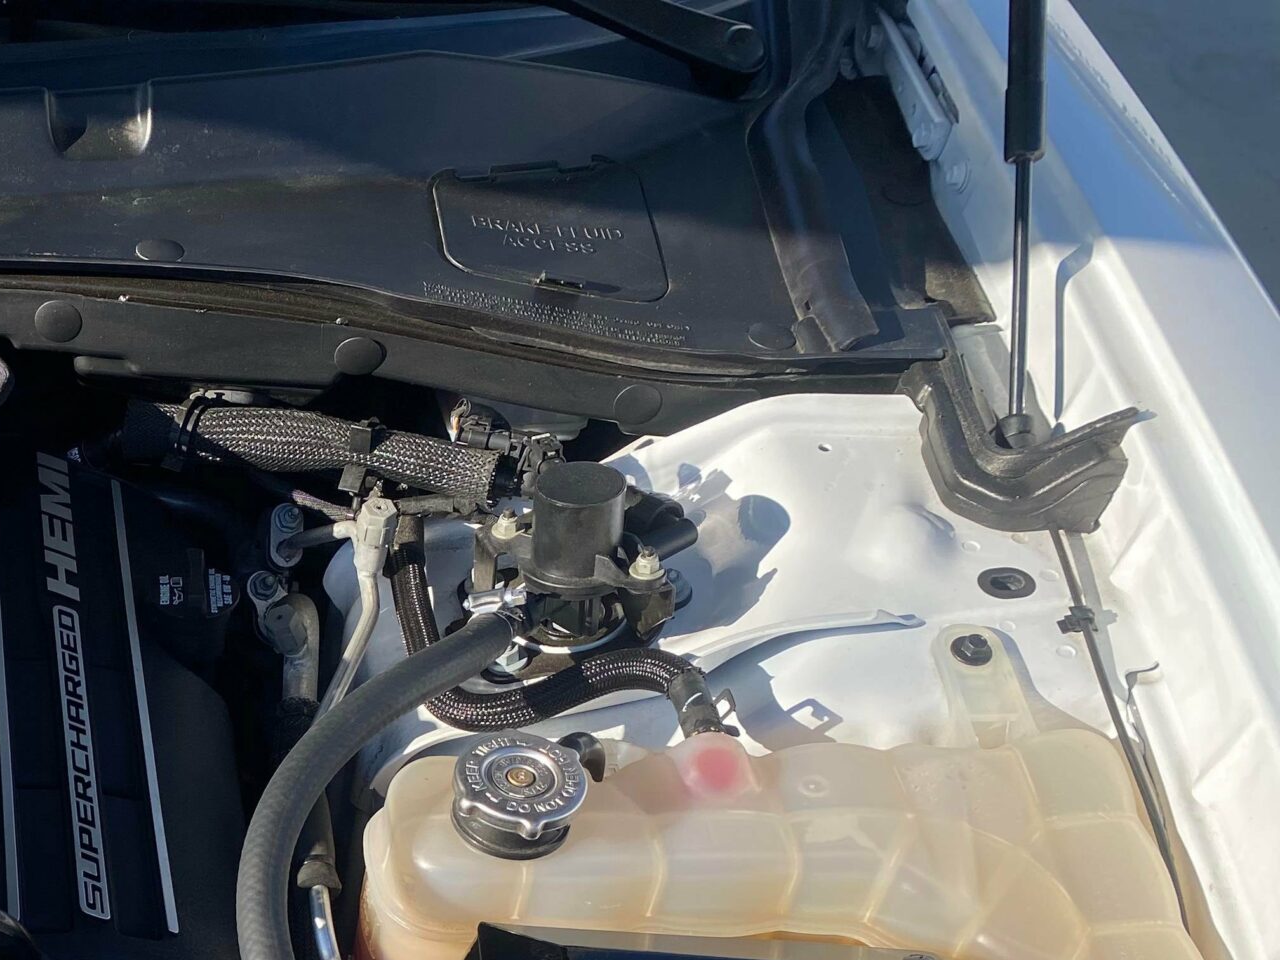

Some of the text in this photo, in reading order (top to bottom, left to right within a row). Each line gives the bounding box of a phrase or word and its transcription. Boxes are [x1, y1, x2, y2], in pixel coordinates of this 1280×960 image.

[471, 215, 623, 241] BRAKE FLUID
[503, 233, 596, 254] ACCESS
[36, 451, 110, 918] SUPERCHARGED HEMI
[506, 800, 531, 813] DO
[534, 795, 565, 813] NOT
